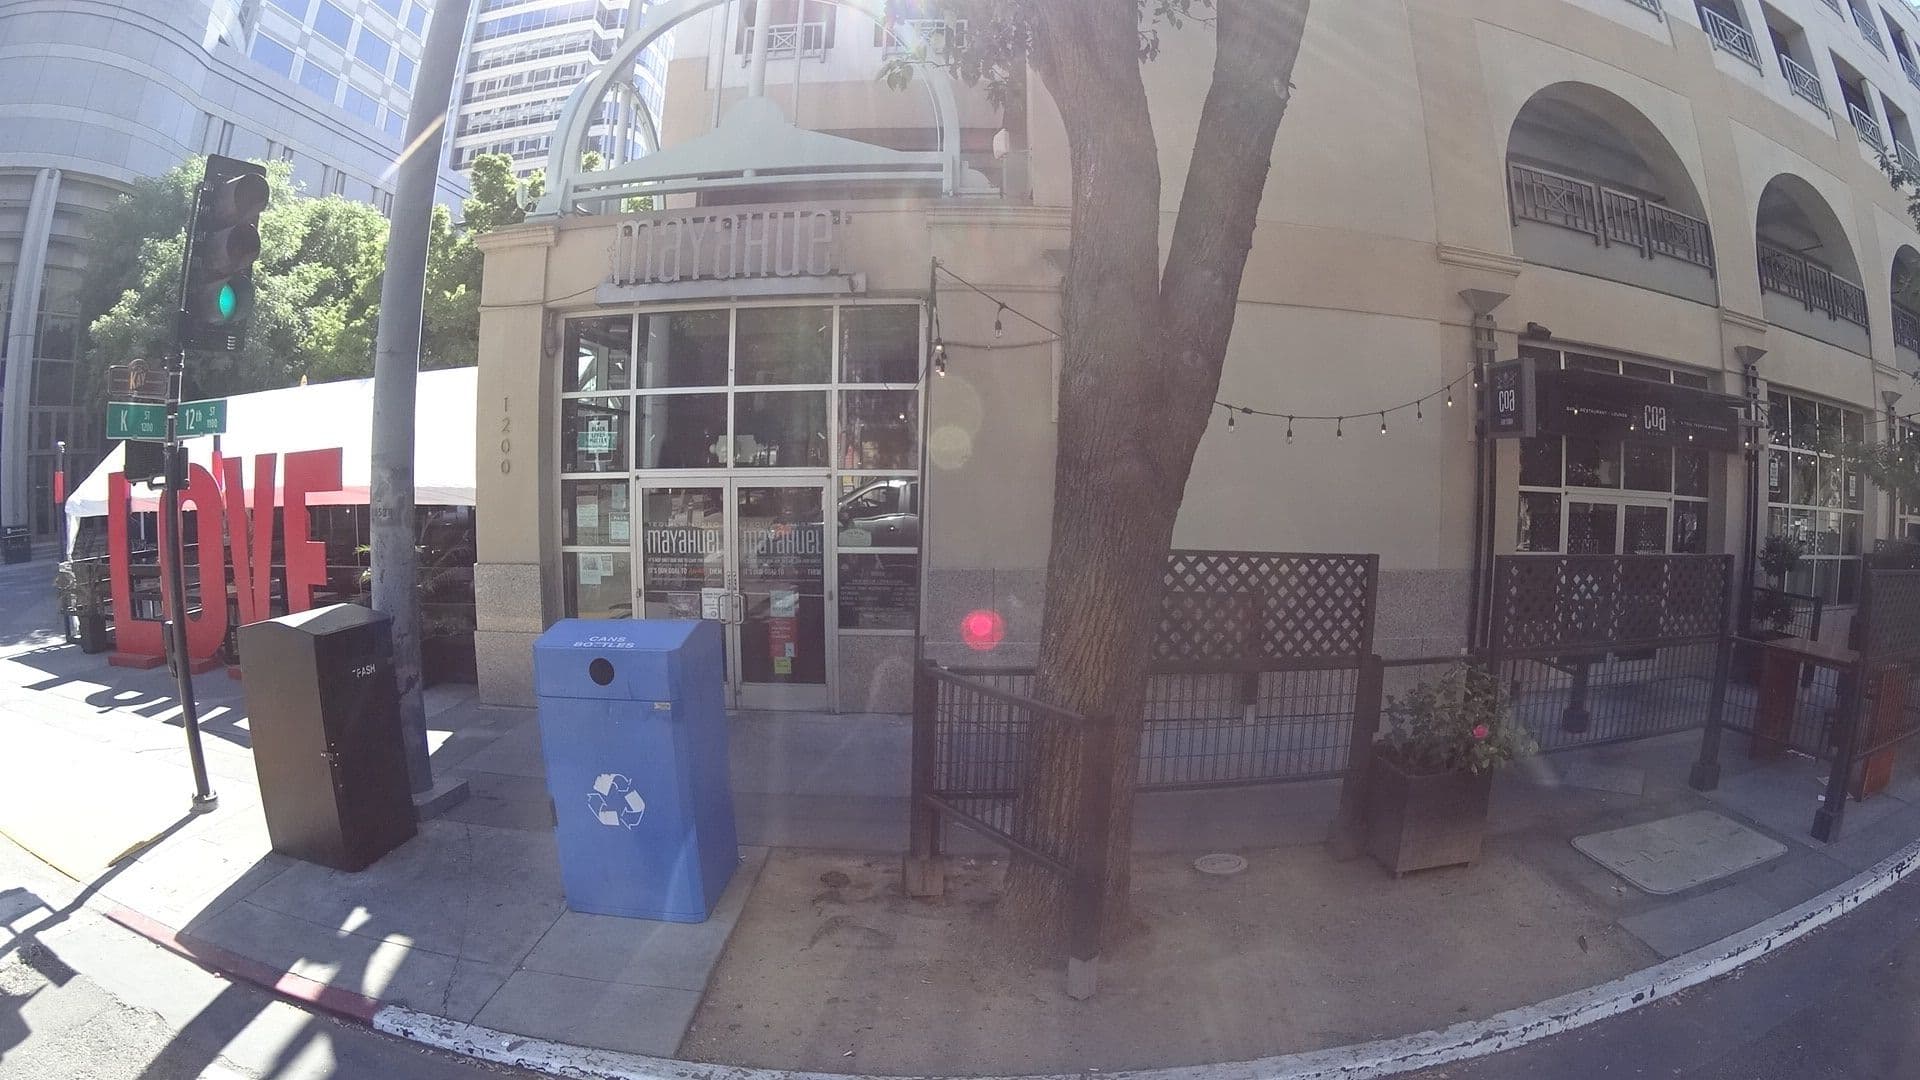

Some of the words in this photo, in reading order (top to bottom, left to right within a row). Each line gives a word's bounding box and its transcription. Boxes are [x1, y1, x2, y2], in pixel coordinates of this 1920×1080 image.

[128, 371, 146, 390] KAY
[120, 410, 129, 432] K
[144, 411, 151, 420] ST
[141, 423, 153, 432] 1200
[185, 408, 203, 430] 12th
[209, 406, 216, 416] ST
[501, 397, 511, 474] 1200
[108, 447, 343, 658] LOVE
[352, 663, 376, 678] RASH
